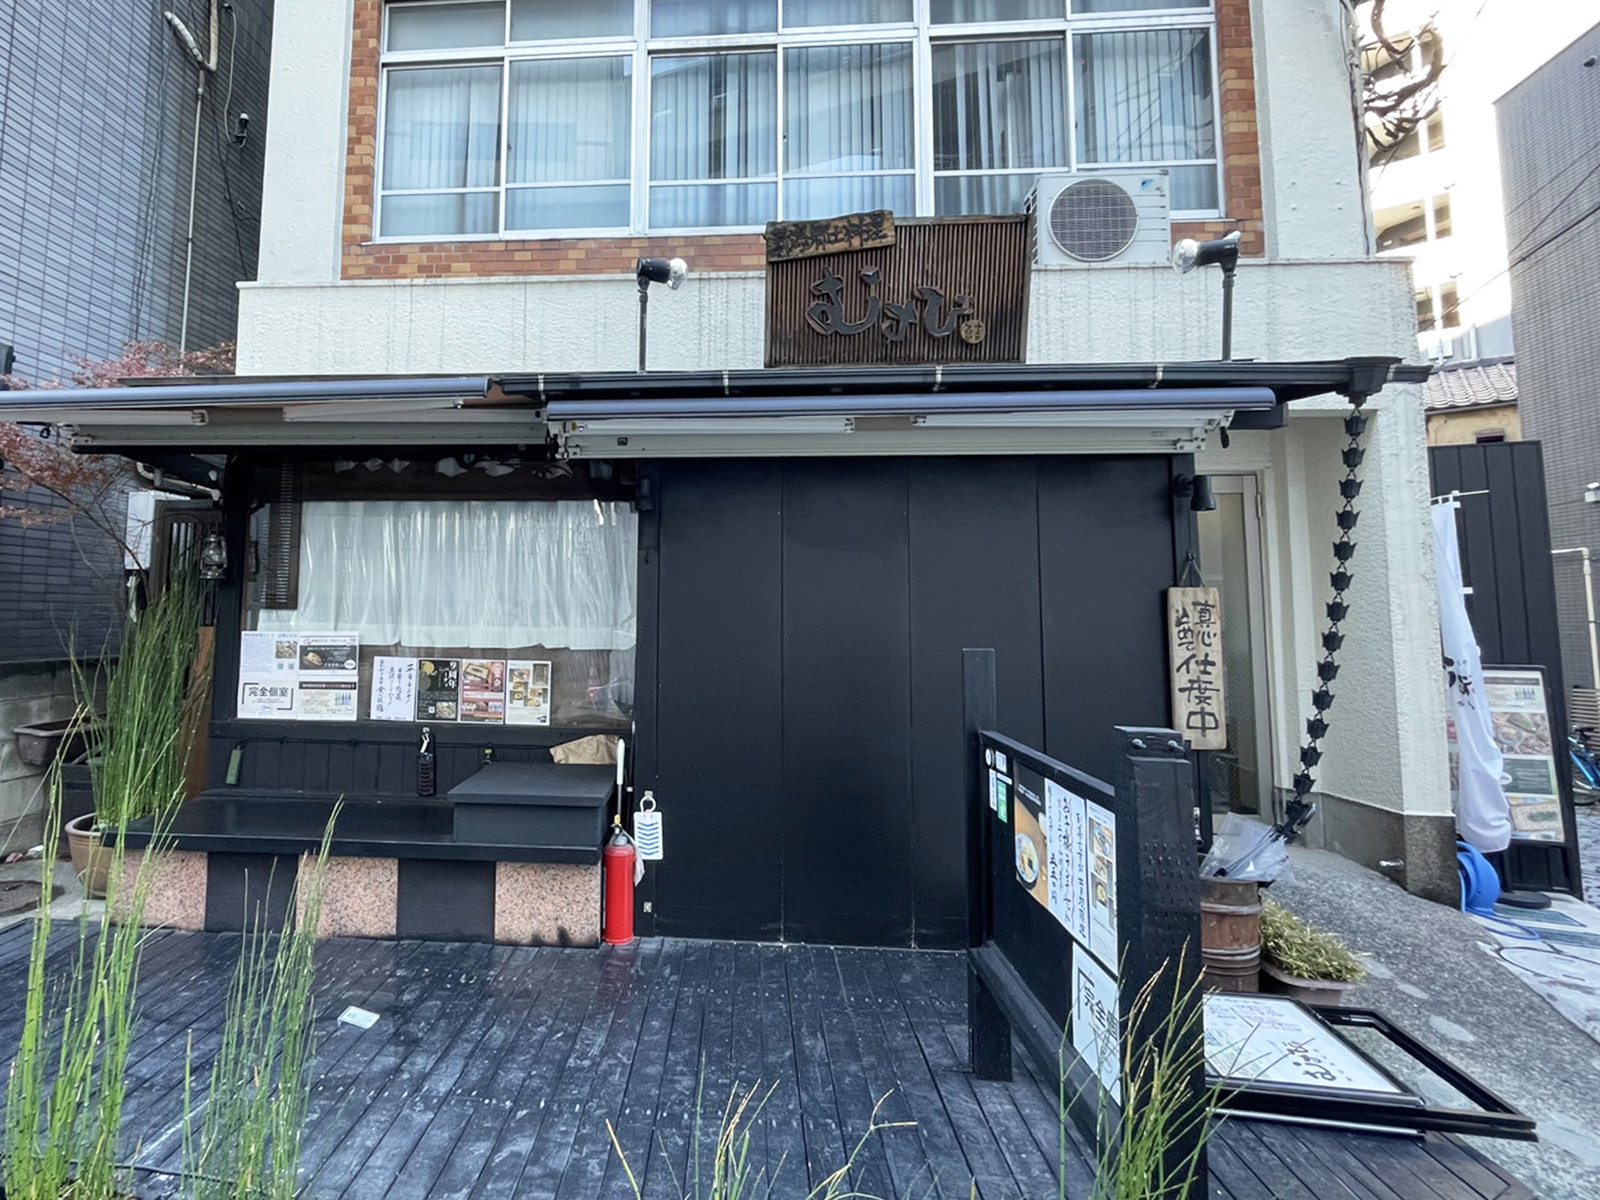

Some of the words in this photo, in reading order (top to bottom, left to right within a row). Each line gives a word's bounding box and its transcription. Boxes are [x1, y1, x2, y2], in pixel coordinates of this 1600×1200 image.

[1175, 607, 1196, 652] 込めて
[1191, 599, 1217, 647] 真心
[248, 686, 289, 697] 完全個室
[1175, 652, 1221, 738] 仕度中
